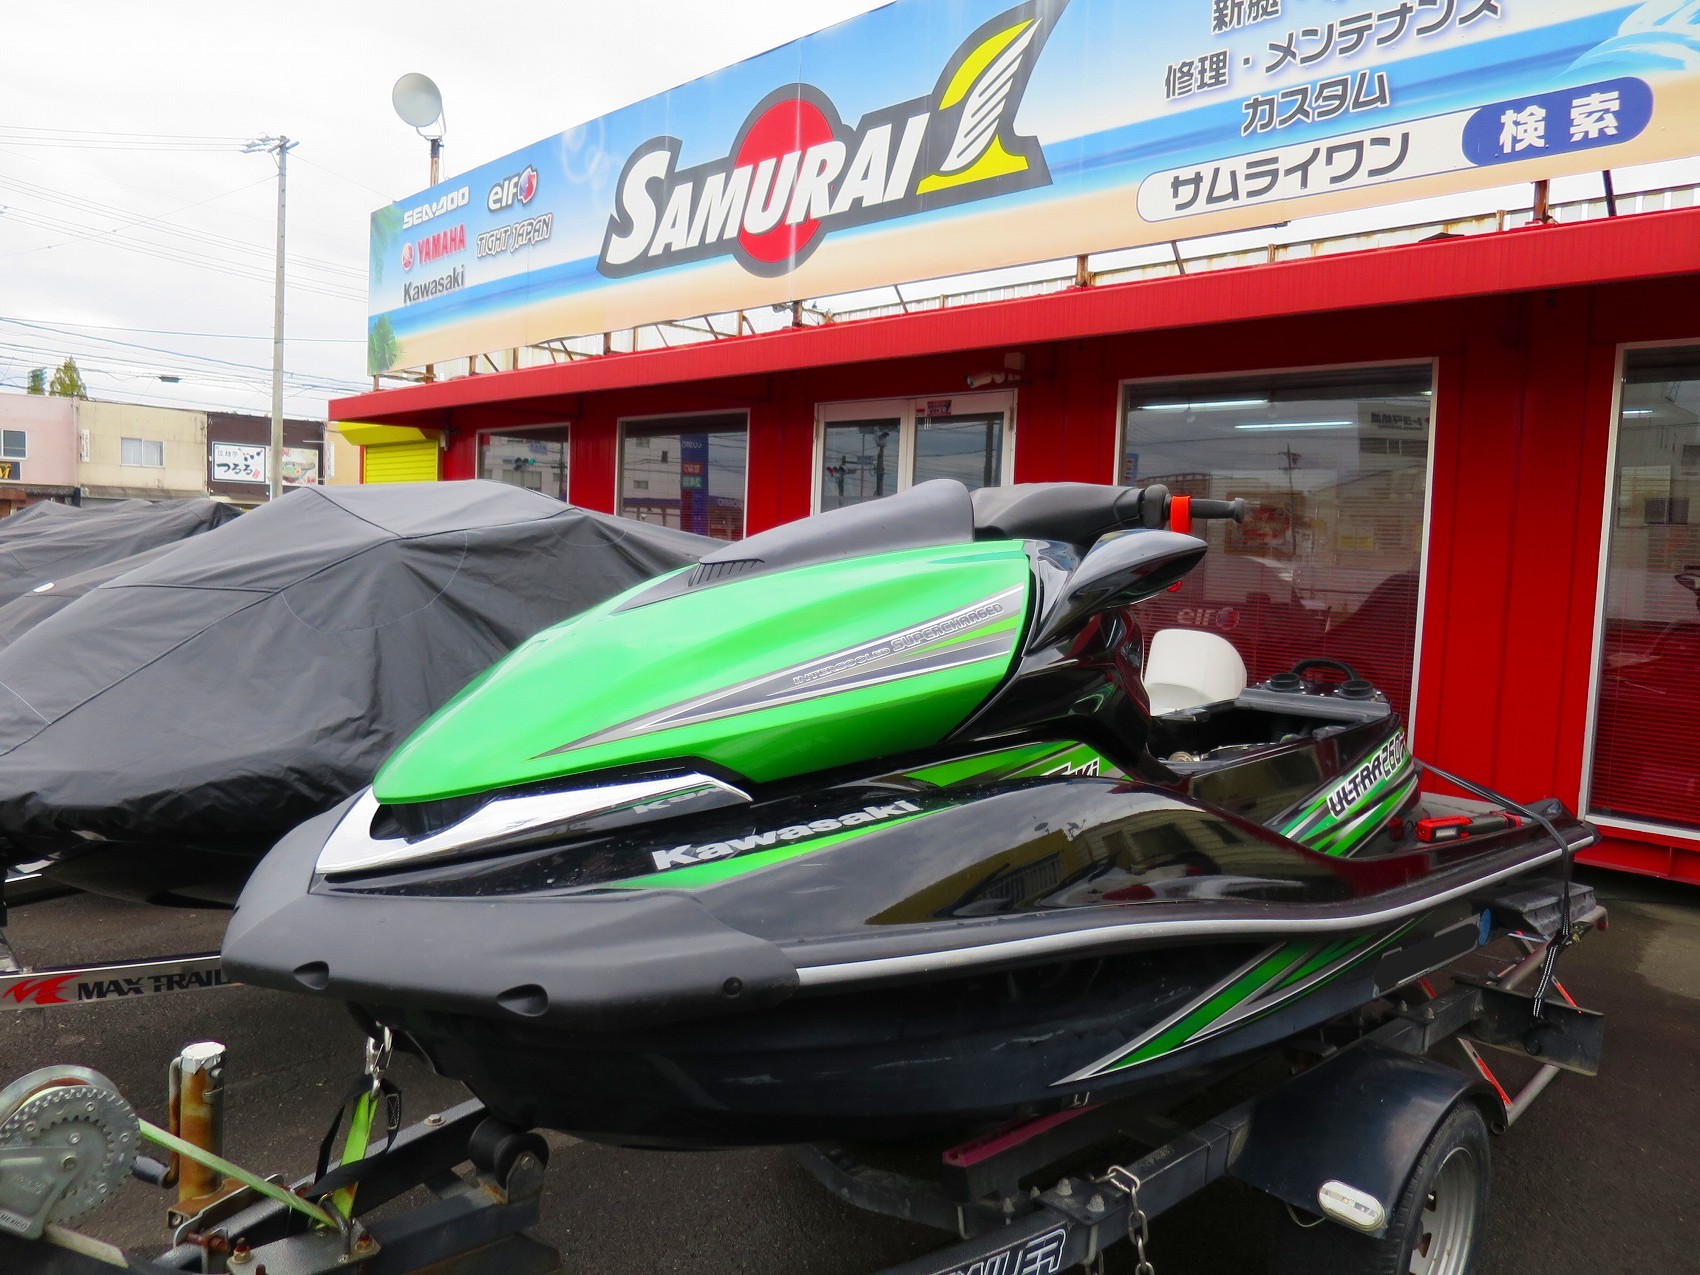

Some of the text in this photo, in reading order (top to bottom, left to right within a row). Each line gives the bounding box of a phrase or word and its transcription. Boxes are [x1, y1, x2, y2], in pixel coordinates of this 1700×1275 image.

[1242, 72, 1390, 135] カスタム
[488, 177, 519, 211] elf
[605, 111, 931, 265] SAMURAI
[1170, 132, 1410, 212] サムライワン
[417, 224, 467, 265] YAMAHA
[477, 226, 511, 257] TIGHT
[403, 264, 465, 304] Kawasaki
[792, 603, 1005, 685] INTERCOOLED SUPERCHARGED
[1327, 750, 1383, 818] ULTRA
[651, 800, 922, 871] Kawasaki
[77, 978, 145, 1001] MAX
